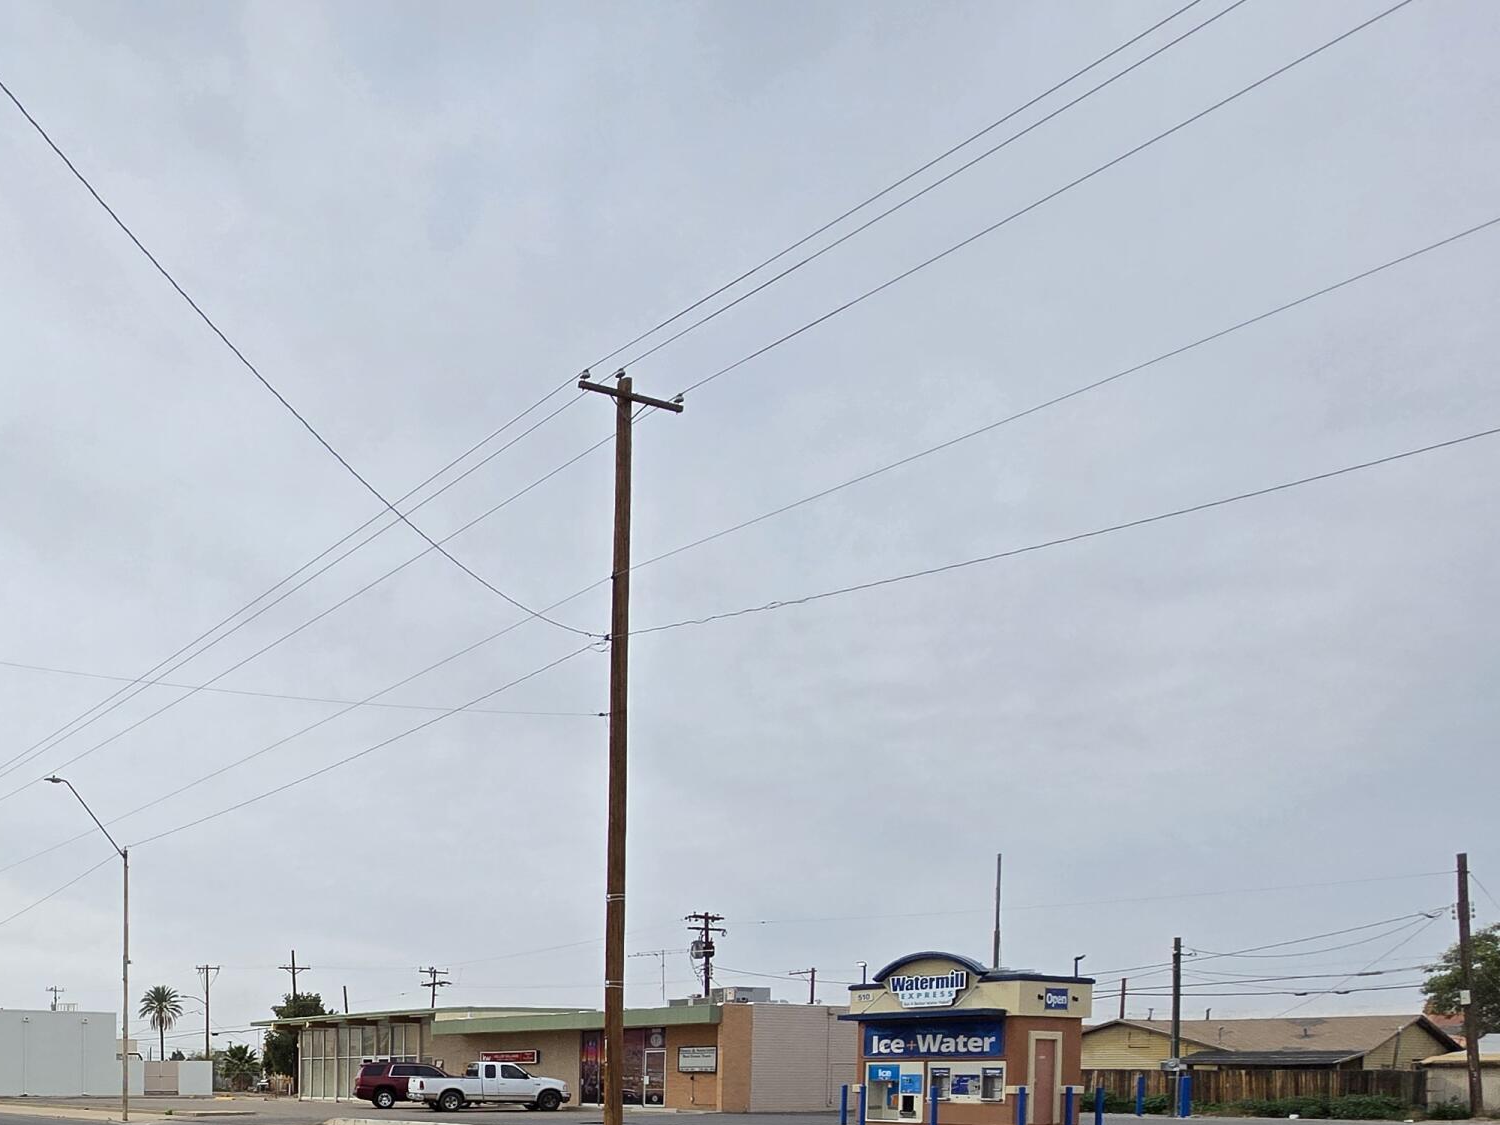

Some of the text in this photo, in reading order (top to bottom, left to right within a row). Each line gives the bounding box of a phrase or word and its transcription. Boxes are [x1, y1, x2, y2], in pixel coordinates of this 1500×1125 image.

[890, 970, 966, 992] Watermill
[901, 990, 953, 1000] EXPRESS
[1046, 993, 1067, 1007] Open
[872, 1035, 905, 1054] Ice
[916, 1033, 996, 1053] Water
[878, 1069, 892, 1077] Ice
